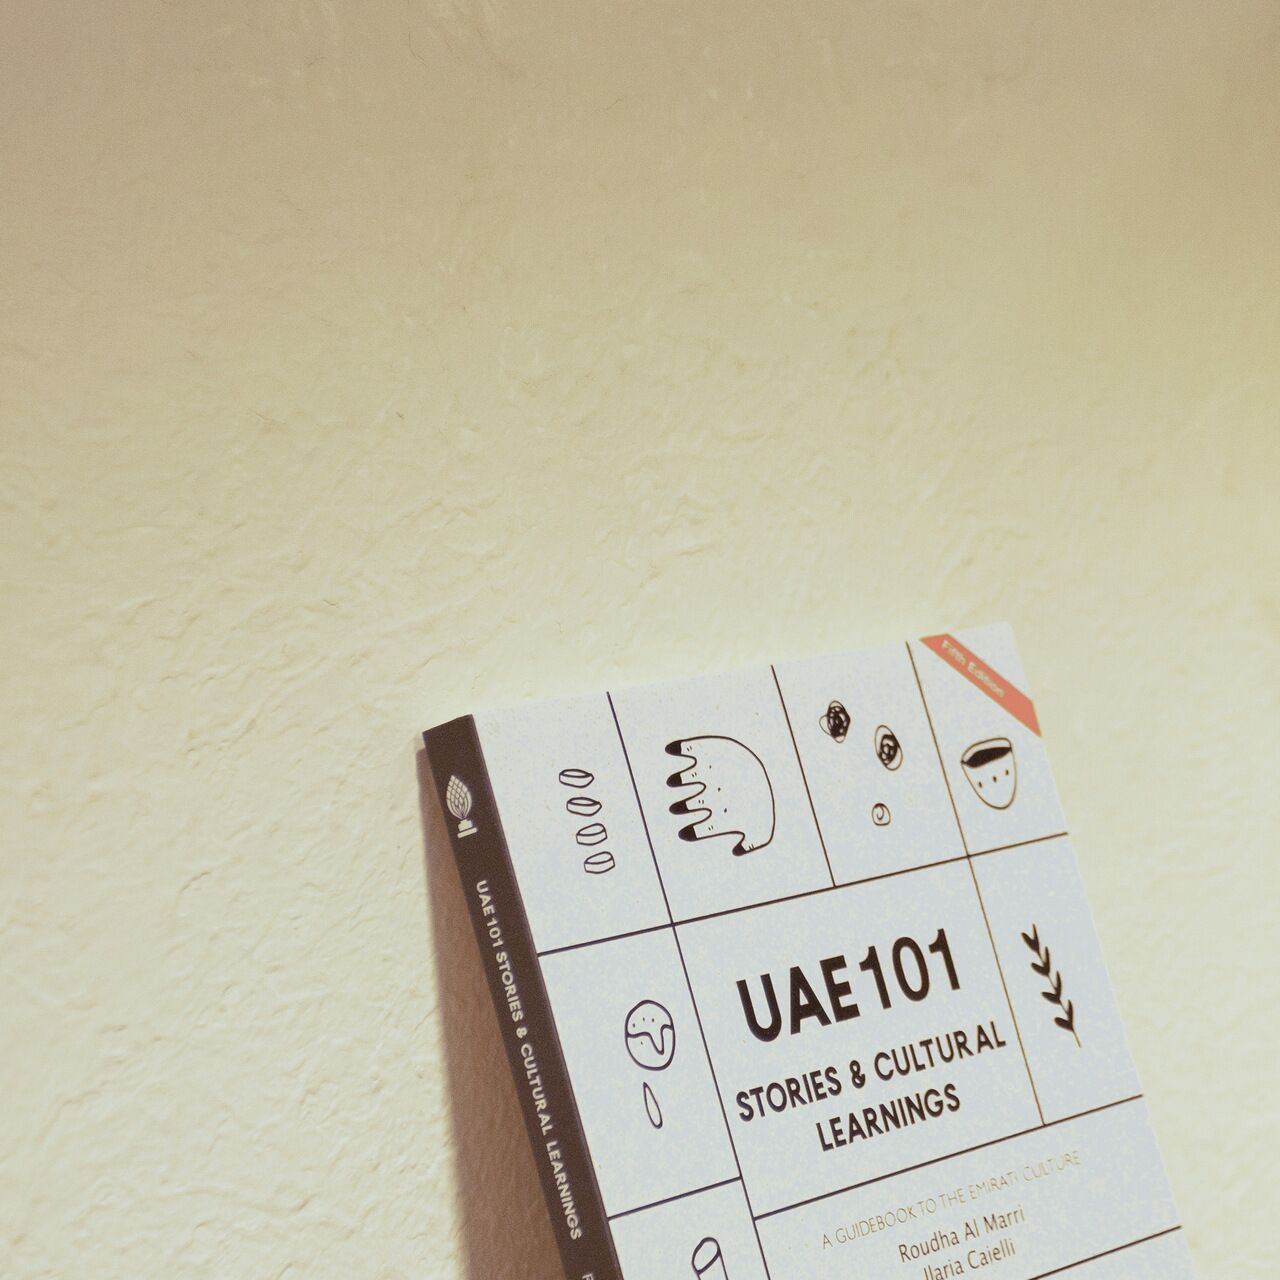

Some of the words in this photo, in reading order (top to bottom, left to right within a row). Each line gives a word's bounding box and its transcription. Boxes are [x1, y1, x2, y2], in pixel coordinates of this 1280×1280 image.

[496, 952, 524, 1022] STORIES
[517, 1027, 528, 1039] &
[520, 1043, 552, 1136] CULTURAL
[736, 1067, 842, 1121] STORIES
[850, 1060, 866, 1089] &
[874, 1021, 1006, 1081] CULTURAL
[816, 1083, 960, 1152] LEARNINGS
[546, 1140, 582, 1240] LEARNINGS
[822, 1234, 833, 1249] A
[836, 1207, 916, 1243] GUIDEBOOK
[917, 1198, 936, 1216] TO
[939, 1188, 966, 1209] THE
[969, 1171, 1019, 1200] EMIRATI
[1022, 1151, 1081, 1182] CULTURE
[899, 1229, 959, 1263] Roudha
[965, 1221, 979, 1240] Al
[984, 1204, 1026, 1234] Marri
[967, 1238, 1016, 1269] Caielli
